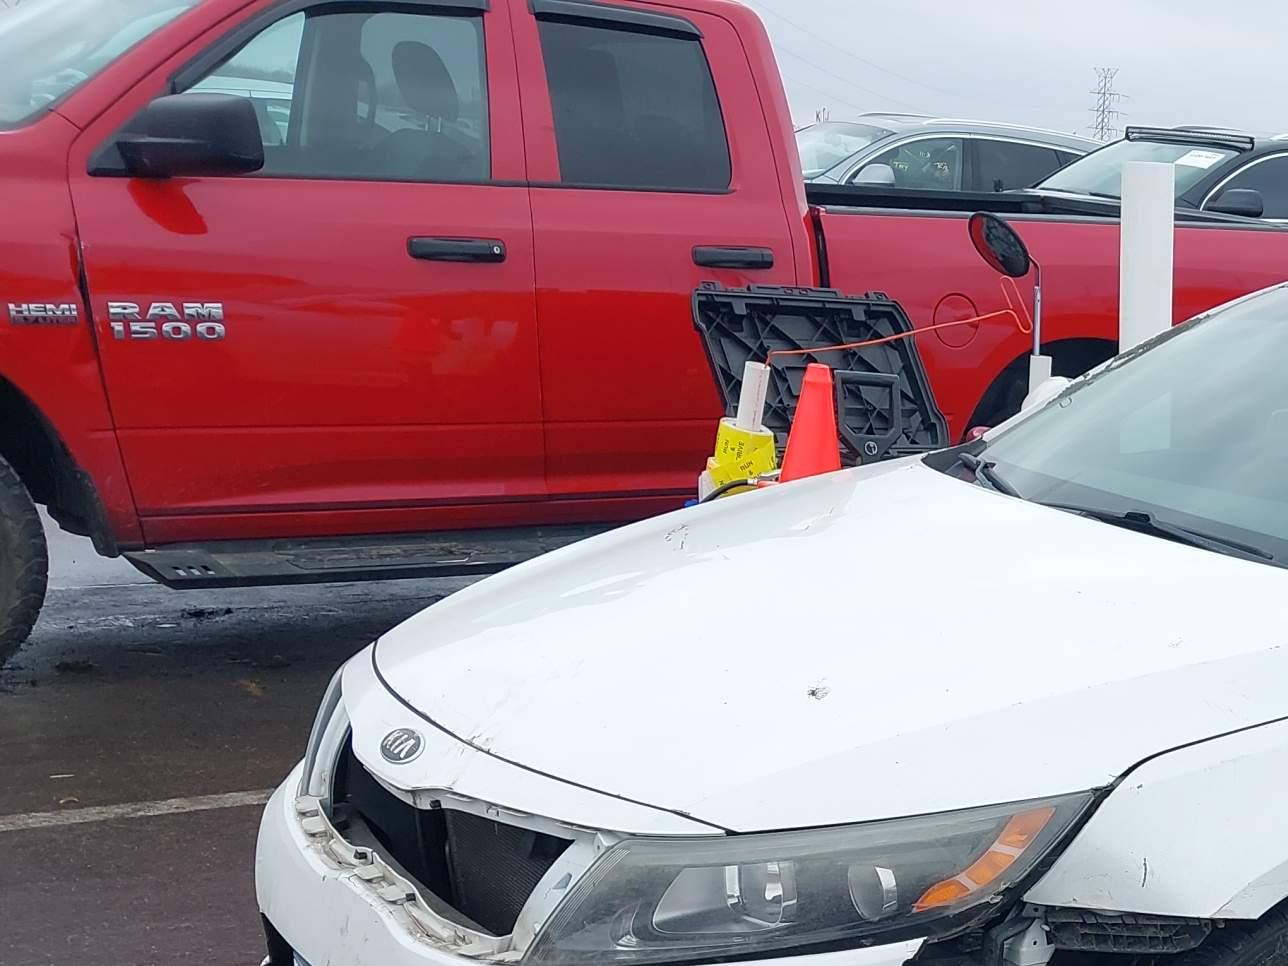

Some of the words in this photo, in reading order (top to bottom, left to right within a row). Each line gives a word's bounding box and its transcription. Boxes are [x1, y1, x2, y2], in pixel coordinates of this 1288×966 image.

[8, 303, 78, 316] HEMI
[107, 302, 224, 320] RAM
[110, 322, 225, 340] 1500
[739, 460, 754, 472] RUN
[381, 729, 419, 760] KIA
